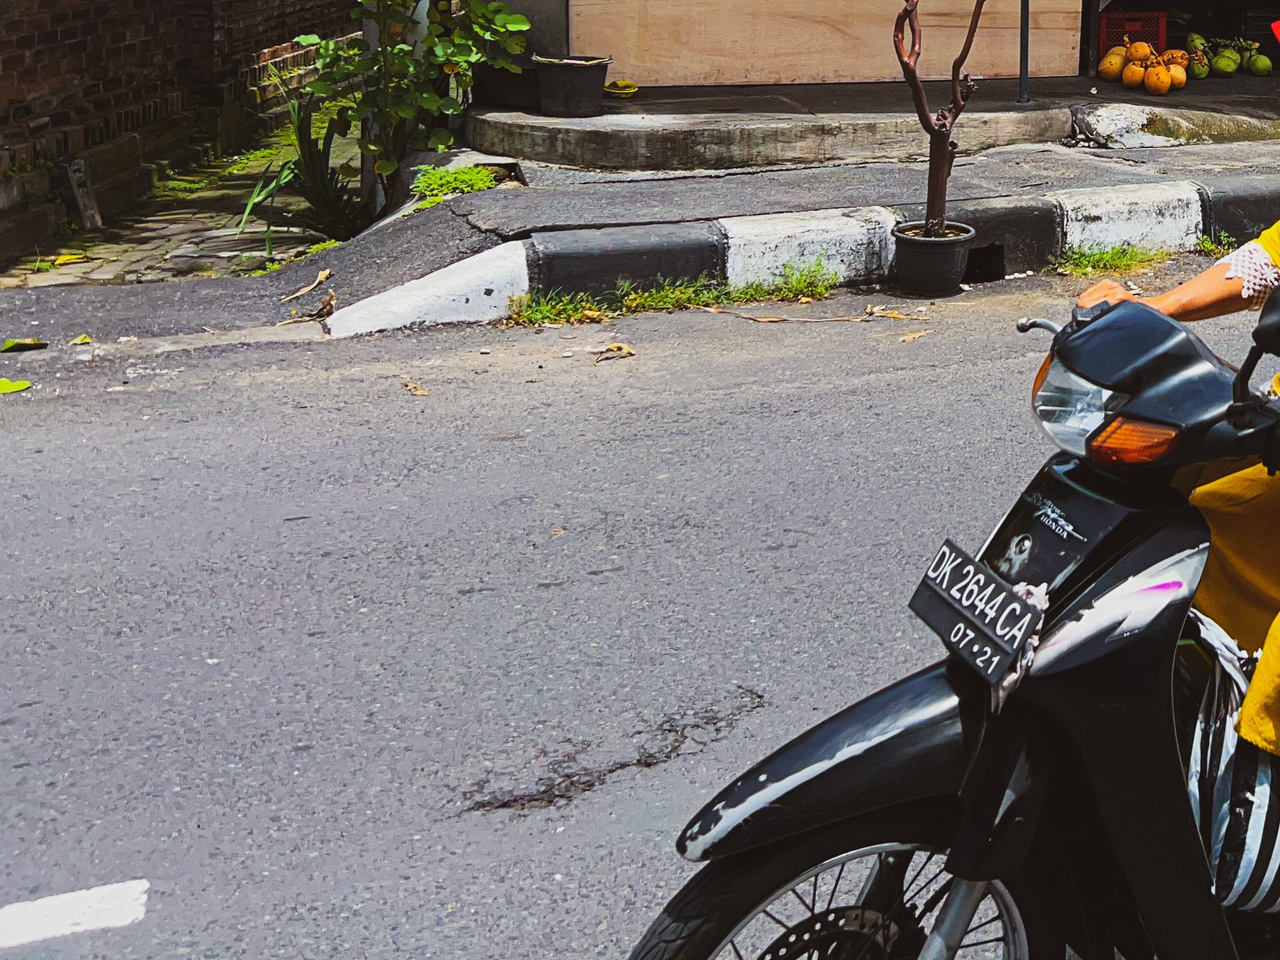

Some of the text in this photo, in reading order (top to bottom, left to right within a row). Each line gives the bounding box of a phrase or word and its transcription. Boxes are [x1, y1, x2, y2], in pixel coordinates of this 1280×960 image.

[1040, 514, 1068, 539] HONDA
[927, 548, 1033, 650] DK 2644 CA
